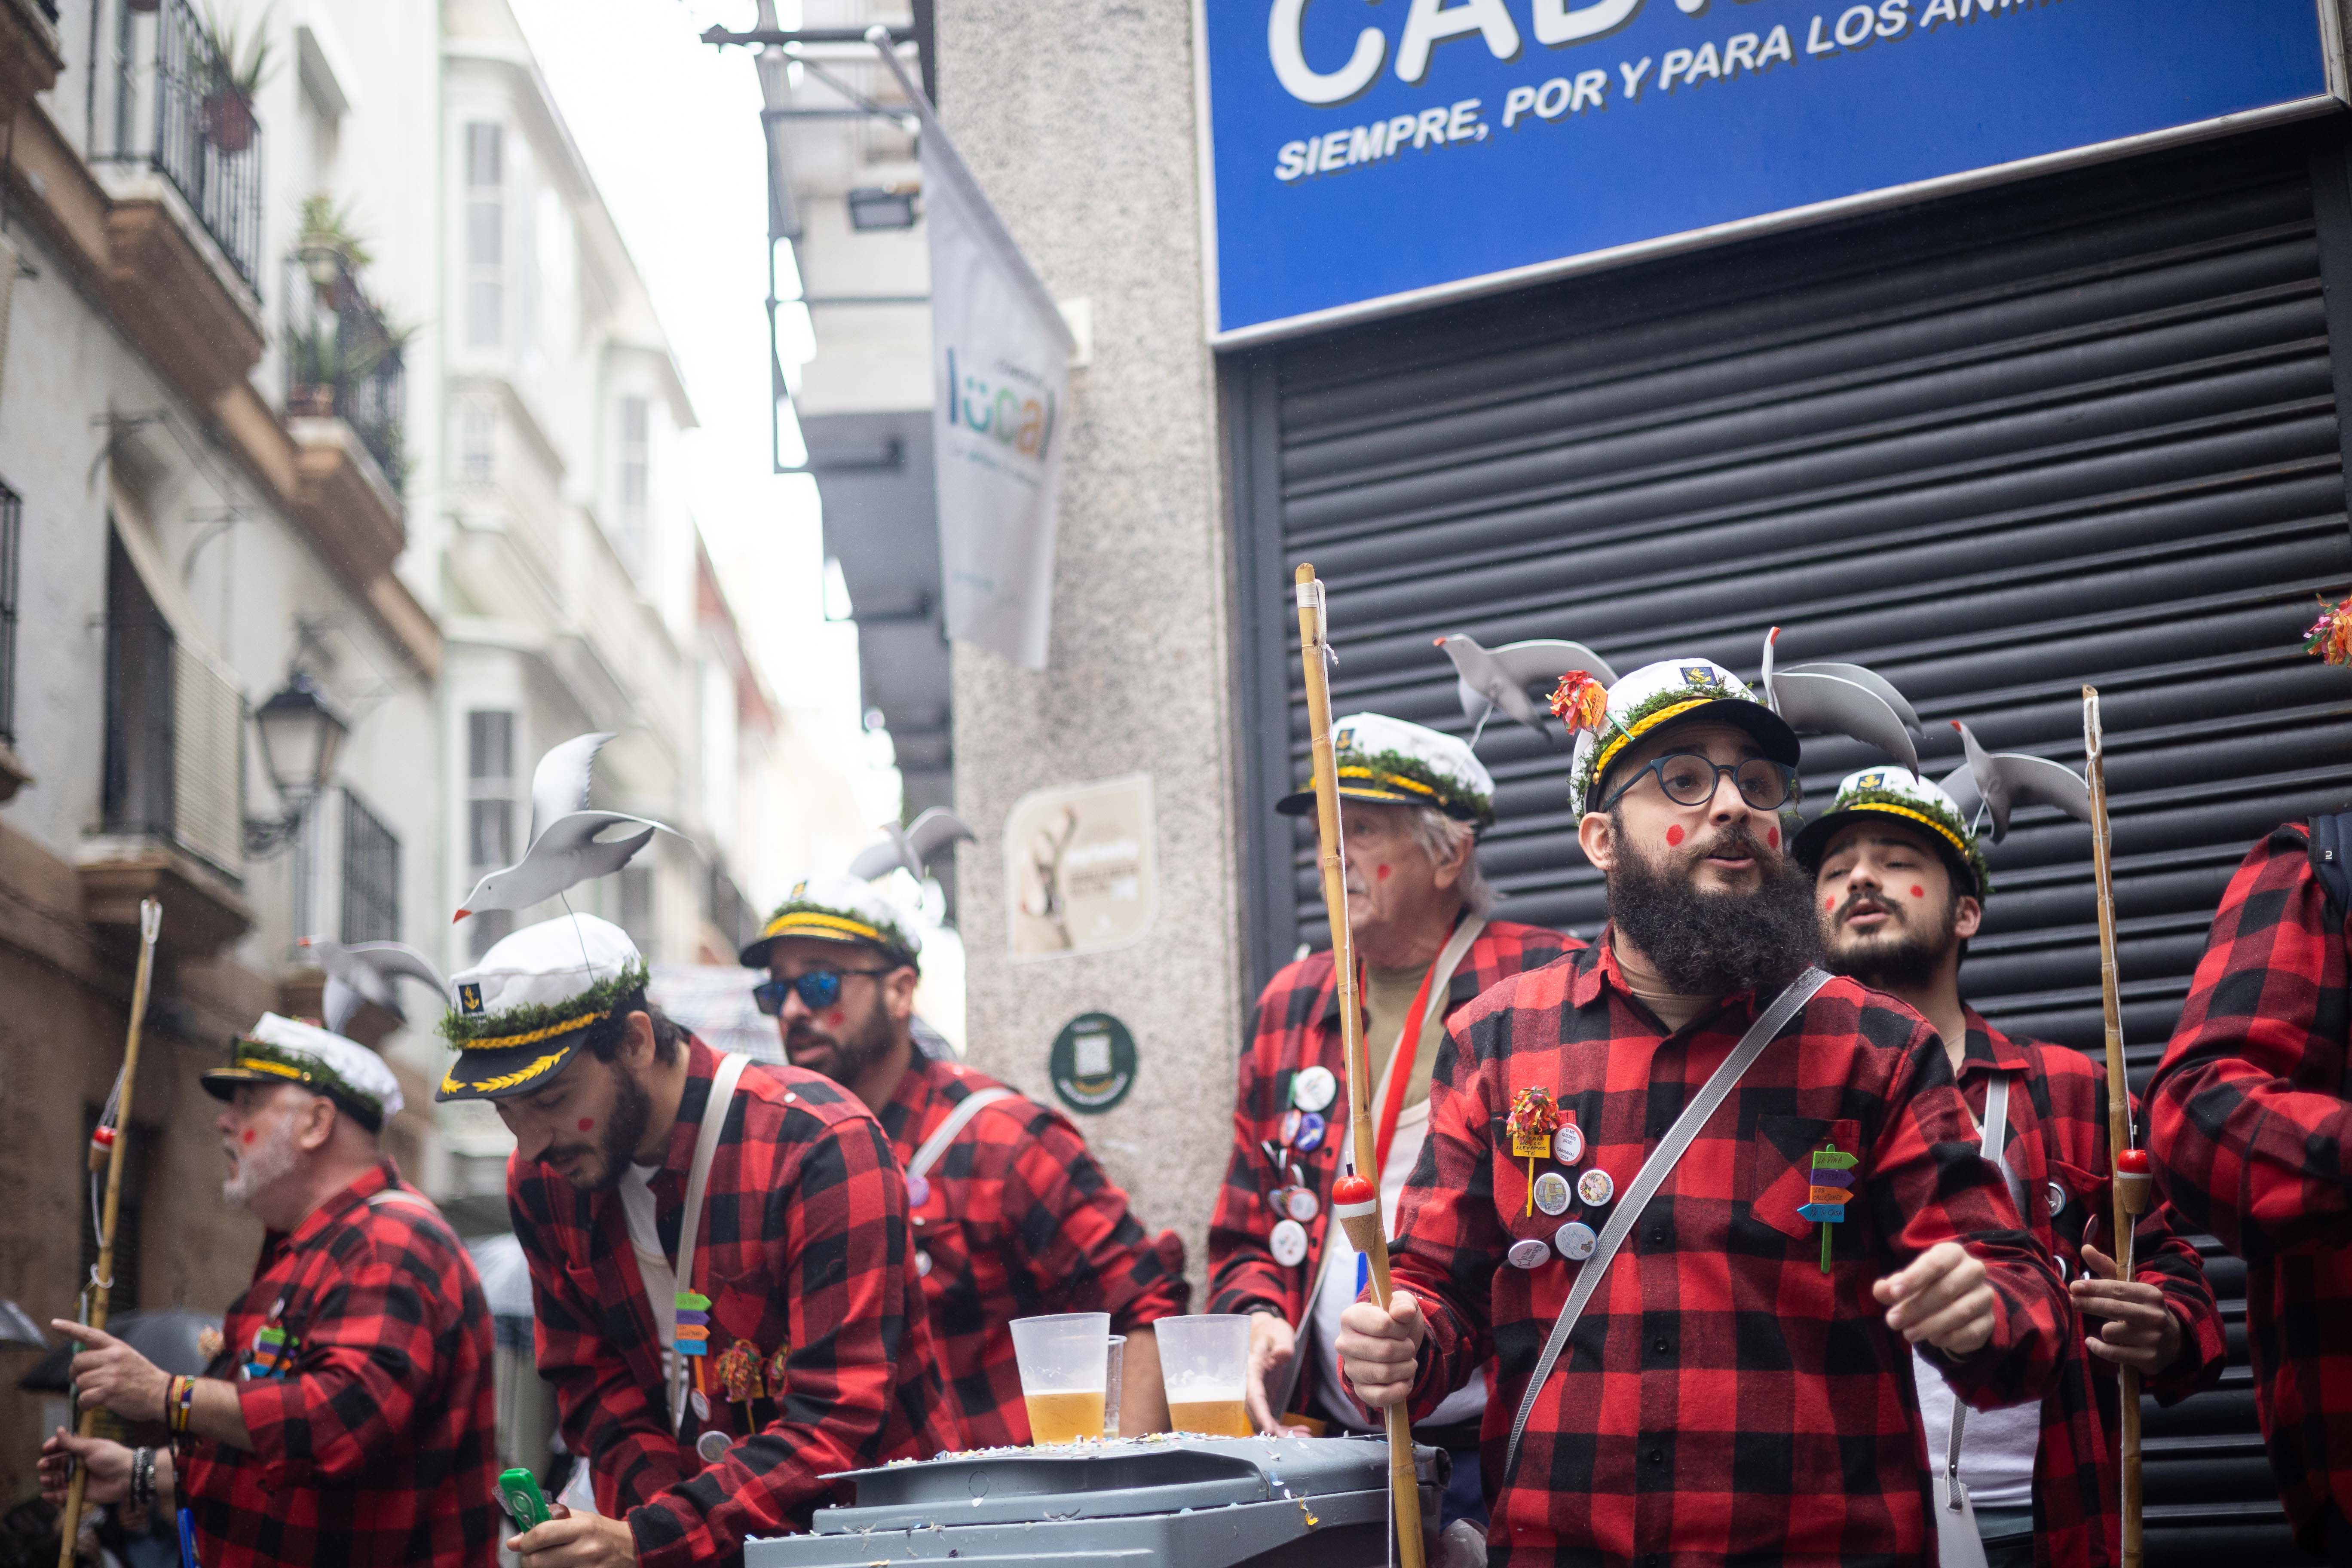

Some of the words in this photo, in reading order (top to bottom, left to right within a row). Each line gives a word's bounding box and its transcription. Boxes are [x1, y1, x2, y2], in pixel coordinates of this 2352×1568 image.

[1274, 98, 1489, 181] SIEMPRE,
[1501, 68, 1607, 128] POR
[1619, 56, 1652, 99] Y
[1658, 24, 1792, 90] PARA
[1806, 0, 1909, 54] LOS
[1556, 1146, 1575, 1158] CARNAVAL
